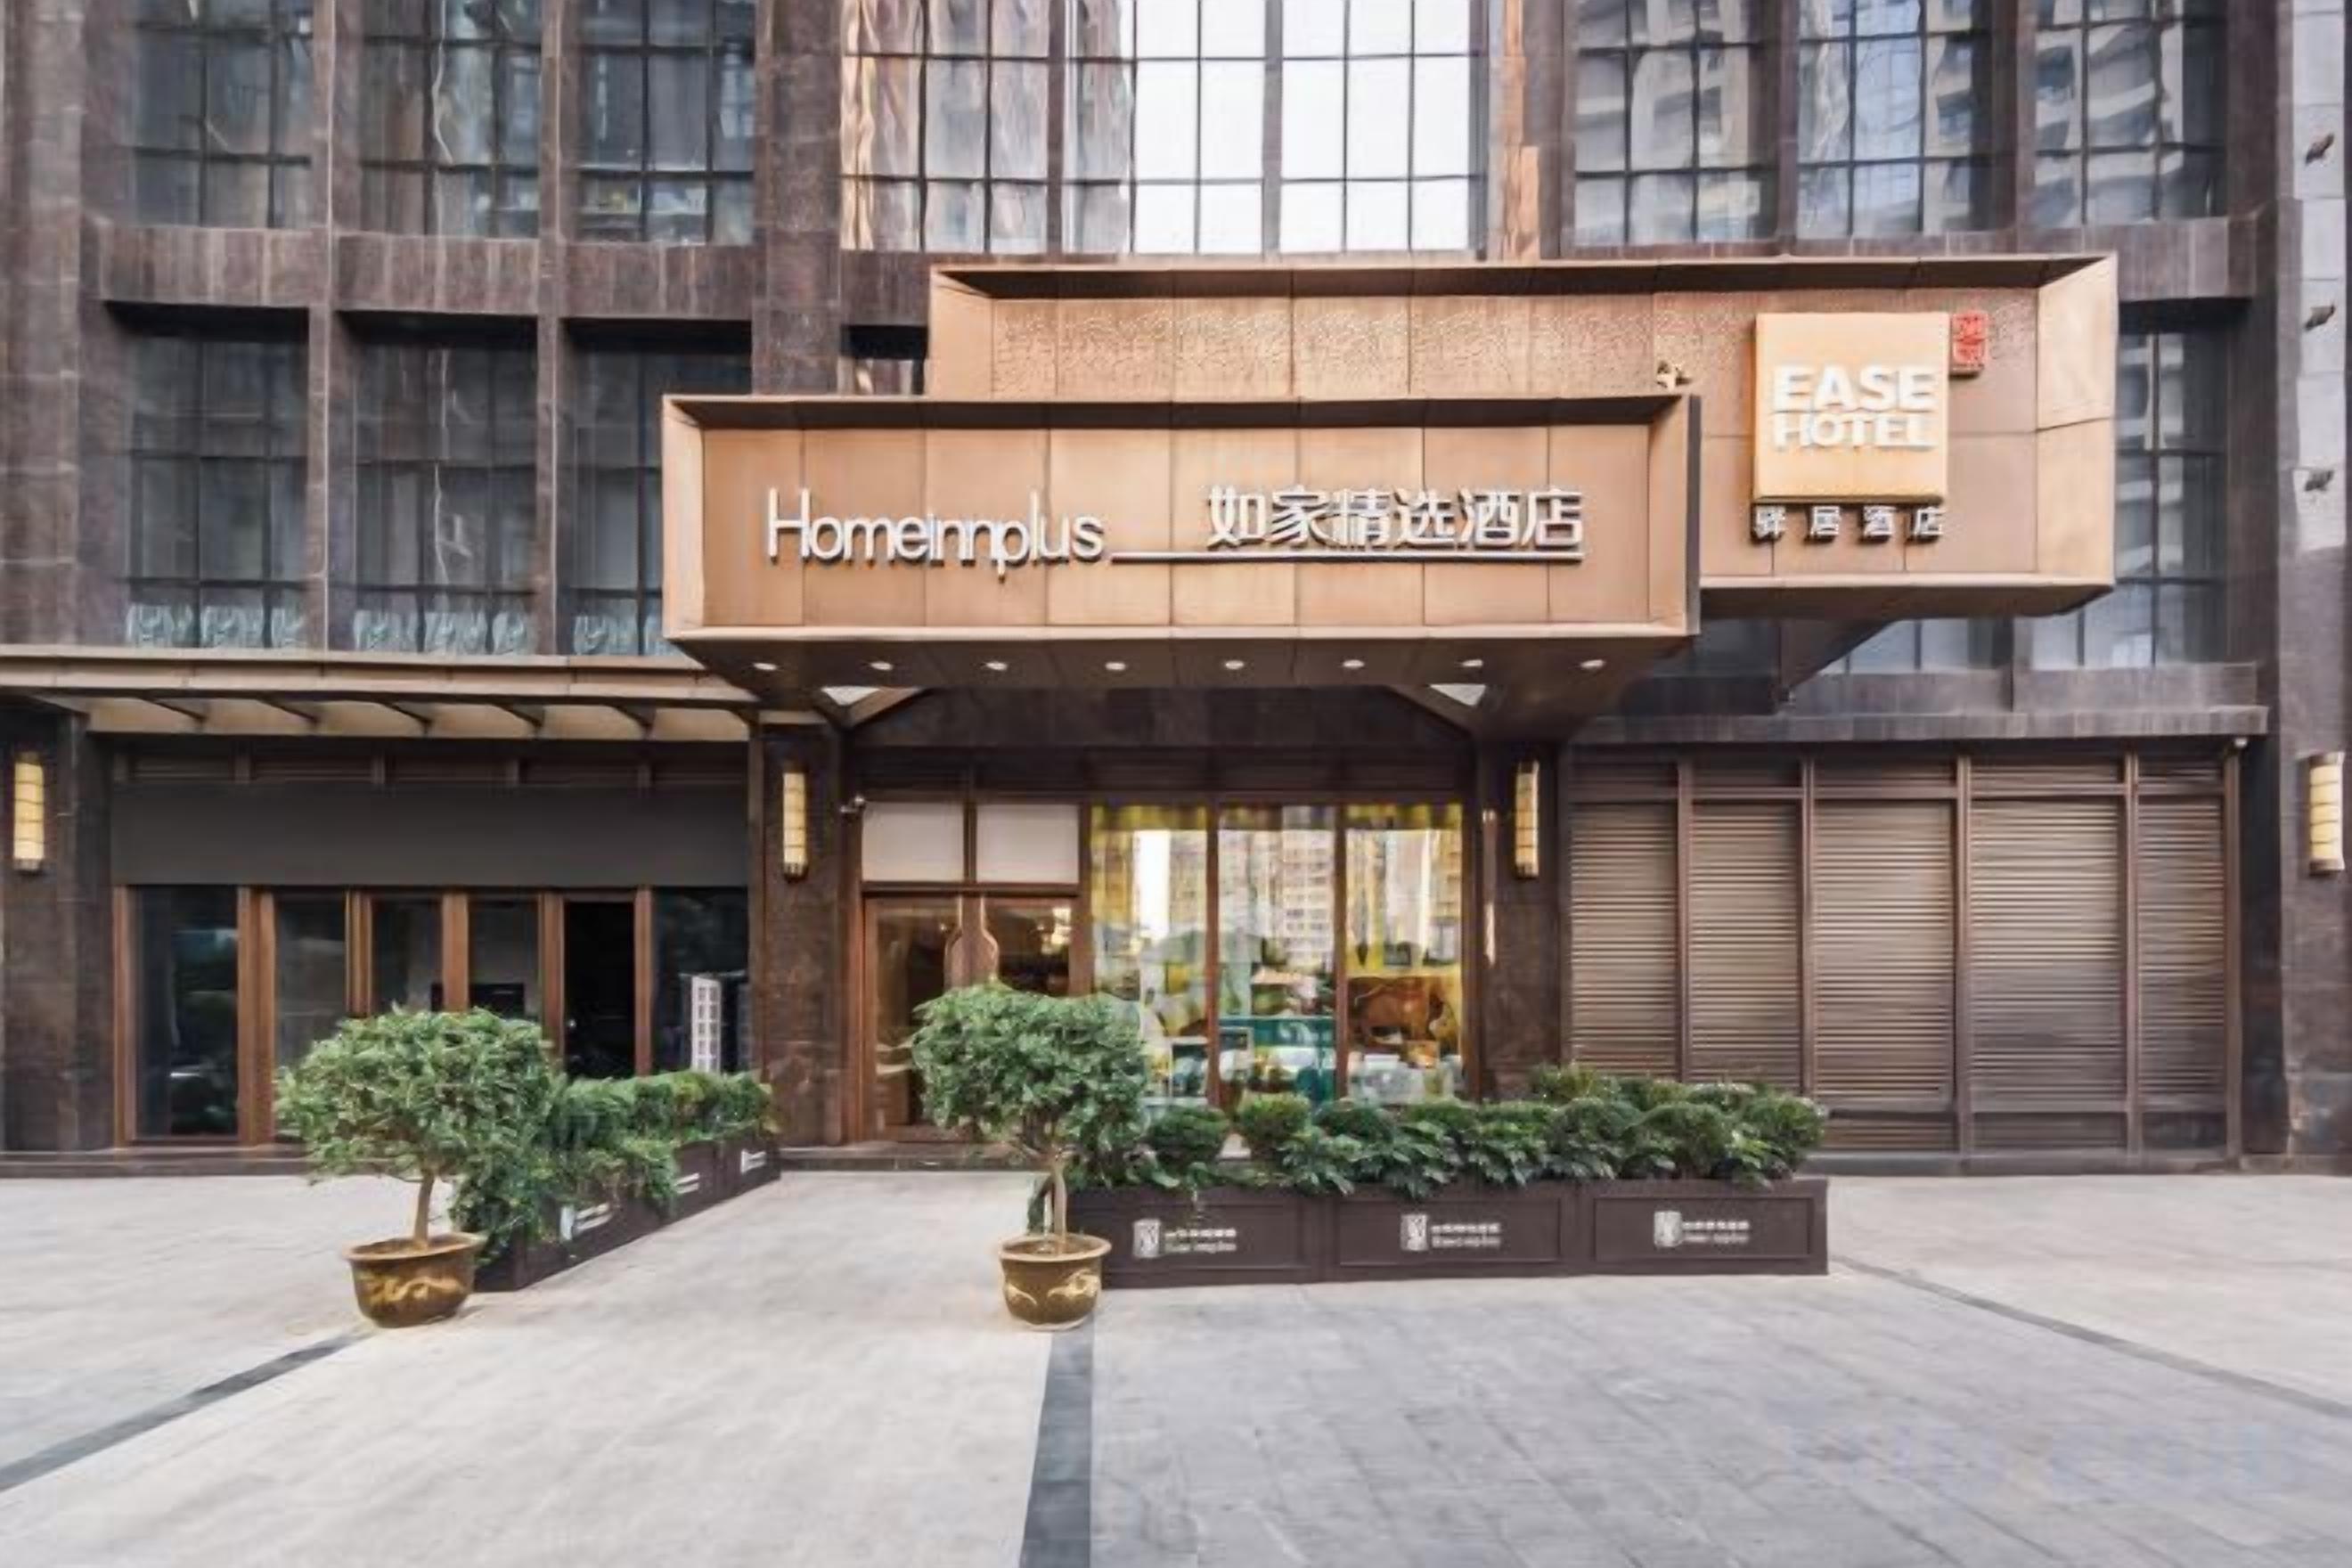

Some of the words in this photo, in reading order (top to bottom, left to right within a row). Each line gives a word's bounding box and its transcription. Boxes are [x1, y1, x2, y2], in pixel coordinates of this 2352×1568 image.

[1772, 364, 1940, 411] EASE
[1772, 412, 1940, 449] HOTEL
[767, 486, 1105, 582] Homeinnplus
[1206, 484, 1585, 550] 如家精选酒店
